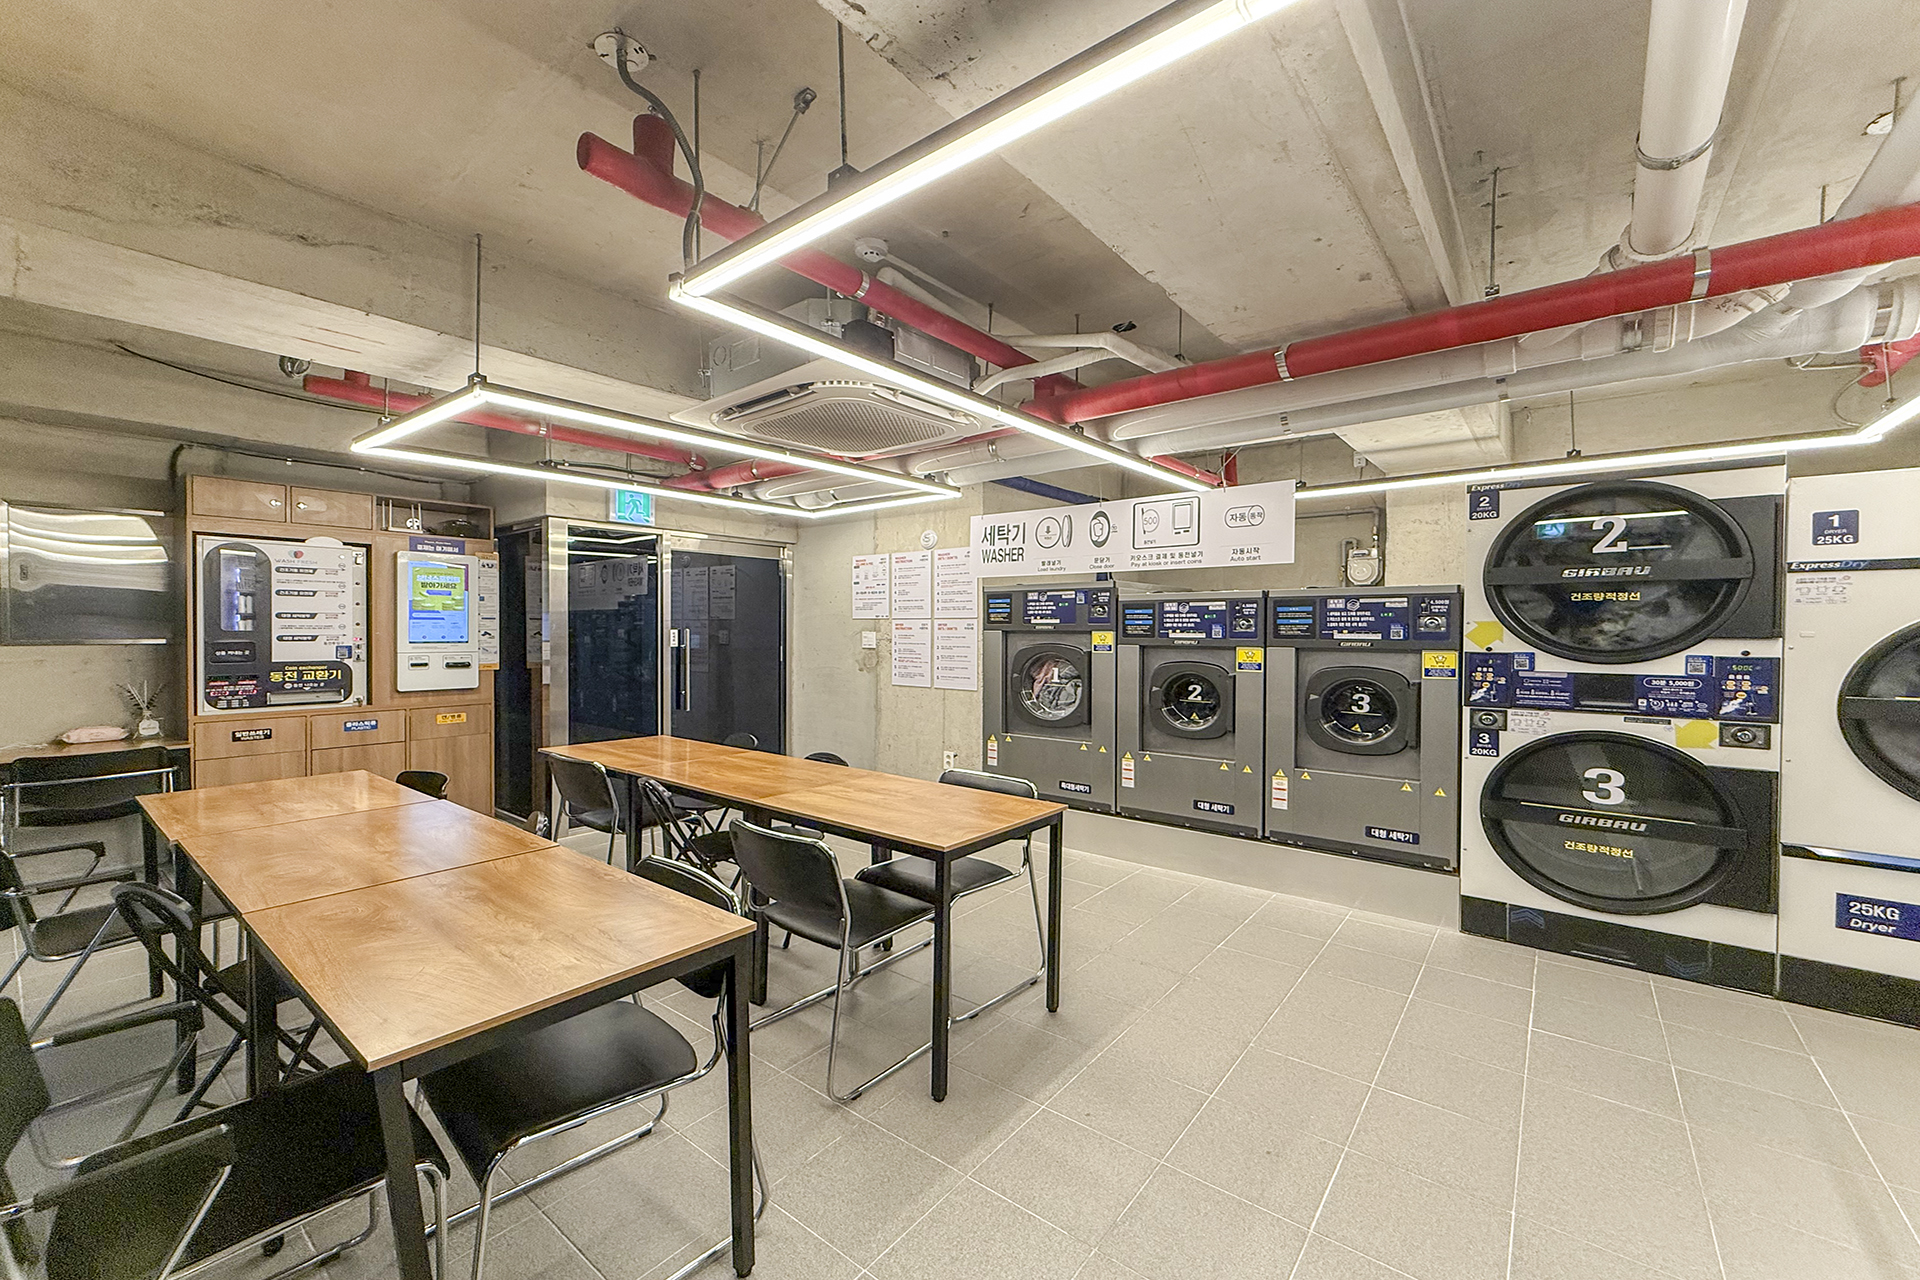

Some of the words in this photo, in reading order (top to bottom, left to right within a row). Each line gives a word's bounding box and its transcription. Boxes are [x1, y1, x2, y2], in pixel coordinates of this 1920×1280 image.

[1479, 496, 1490, 507] 2
[1143, 516, 1157, 525] 500
[1229, 513, 1246, 522] 자동
[1471, 511, 1497, 519] 20KG
[1828, 514, 1840, 527] 1
[981, 522, 1026, 546] 세탁기
[1591, 516, 1628, 554] 2
[1816, 534, 1854, 544] 25KG
[981, 547, 1025, 564] WASHER
[1231, 547, 1260, 555] 자동시작
[1562, 566, 1651, 578] GIRBAU
[1790, 560, 1868, 571] ExpressDry
[1571, 591, 1641, 601] 건조량적정선
[270, 671, 297, 682] 동전
[302, 669, 341, 680] 교환기
[1050, 667, 1060, 683] 1
[1187, 684, 1202, 701] 2
[1351, 693, 1371, 713] 3
[1478, 732, 1490, 744] 3
[1471, 748, 1497, 756] 20KG
[1583, 768, 1625, 805] 3
[1558, 814, 1647, 832] GIRBAU
[1370, 828, 1386, 839] 대형
[1389, 831, 1413, 843] 세탁기
[1564, 840, 1634, 859] 건조량적정선
[1848, 901, 1900, 920] 25KG
[1850, 918, 1897, 933] Dryer
